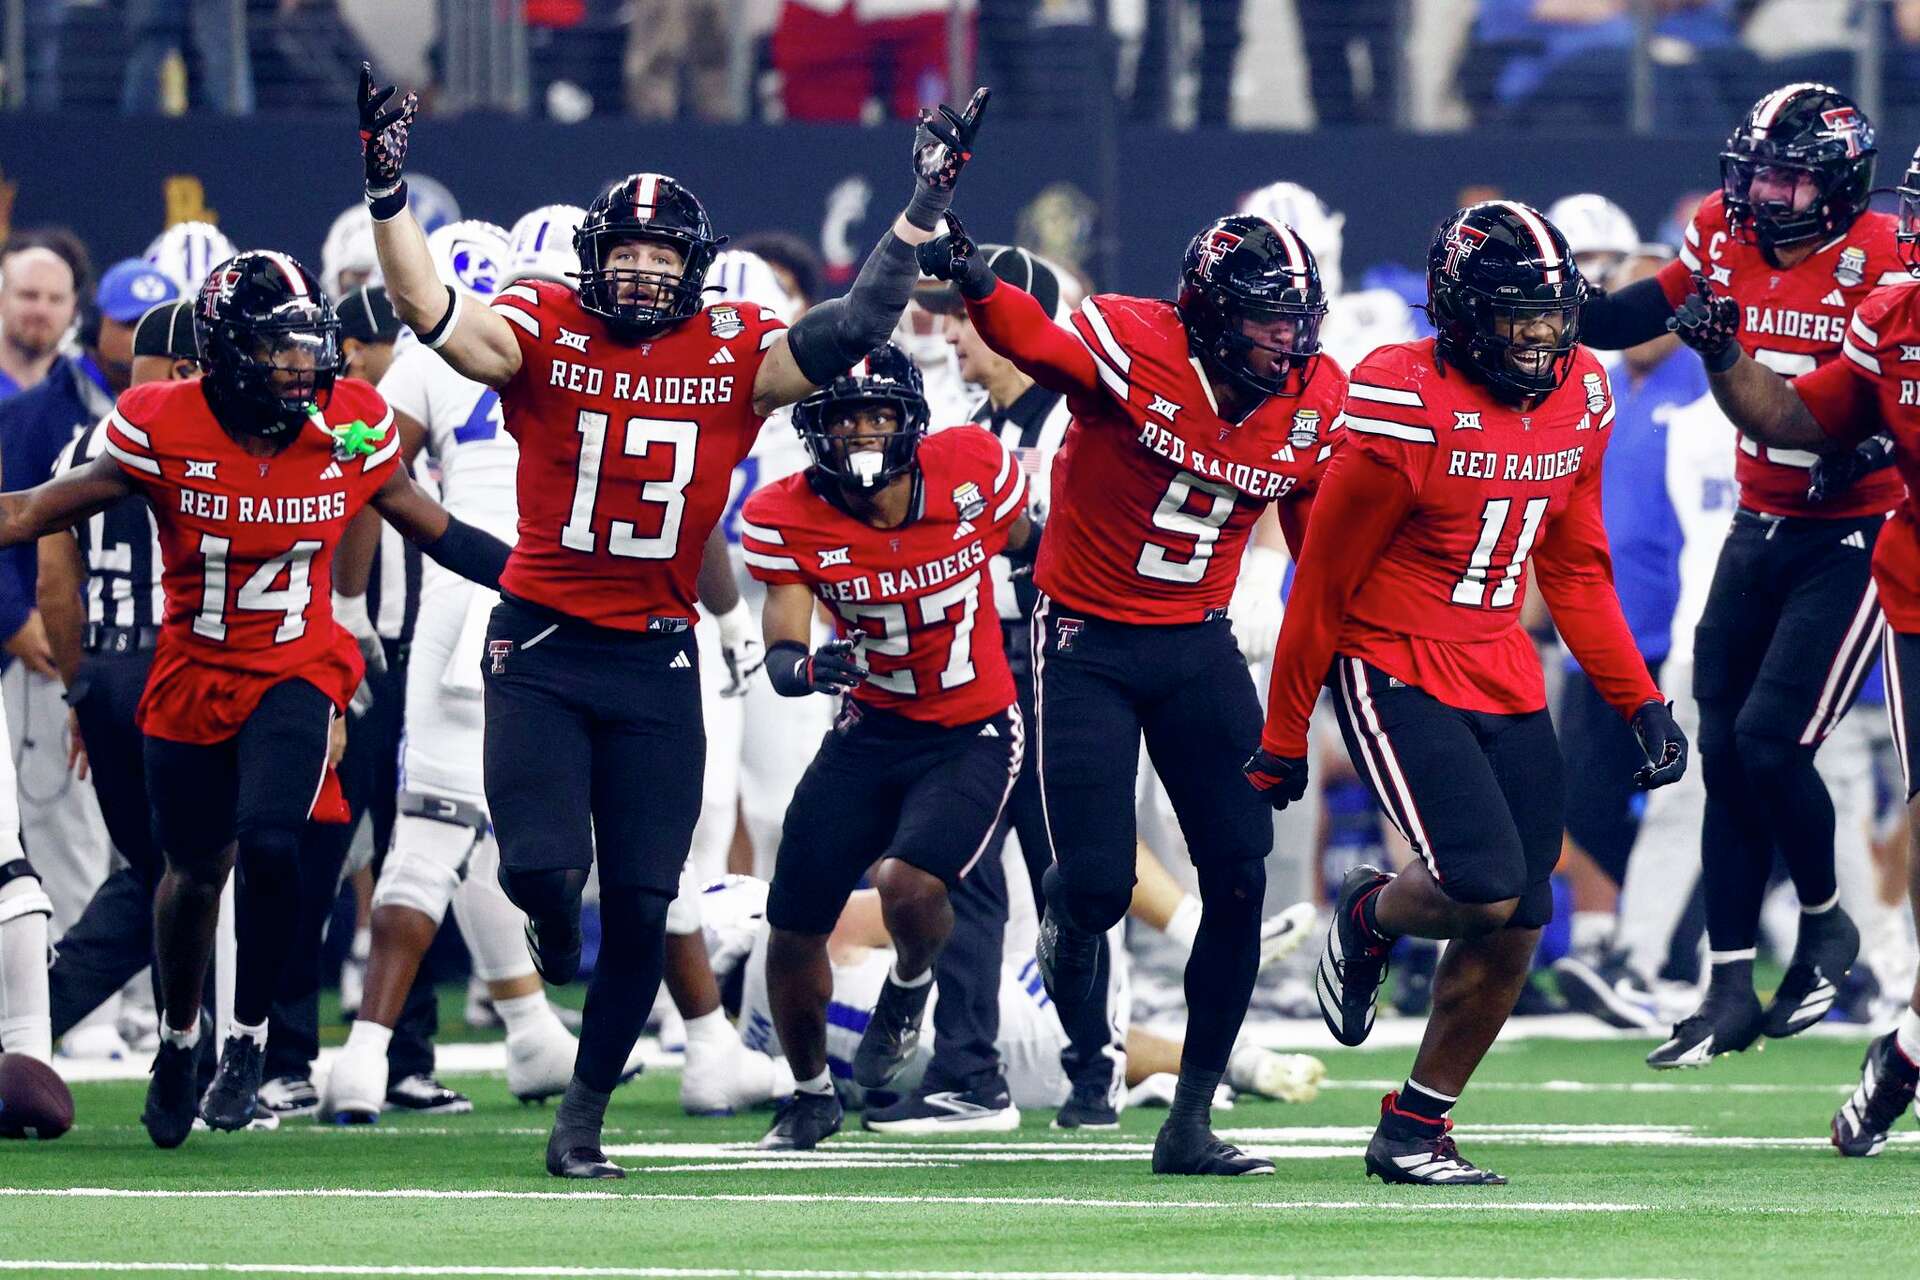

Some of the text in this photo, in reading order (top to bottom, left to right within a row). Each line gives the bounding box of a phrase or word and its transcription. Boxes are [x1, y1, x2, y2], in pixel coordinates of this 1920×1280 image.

[1708, 231, 1727, 260] C
[555, 327, 590, 353] XII
[1745, 306, 1845, 343] RAIDERS
[550, 359, 734, 404] RED RAIDERS
[1147, 394, 1182, 421] XII
[1452, 411, 1483, 431] XII
[185, 460, 217, 480] XII
[1138, 420, 1297, 498] RED RAIDERS
[1448, 446, 1584, 481] RED RAIDERS
[561, 410, 699, 559] 13
[180, 488, 346, 524] RED RAIDERS
[1136, 470, 1240, 583] 9
[817, 547, 851, 569] XII
[819, 540, 986, 602] RED RAIDERS
[1452, 498, 1549, 608] 11
[192, 533, 323, 643] 14
[838, 569, 982, 696] 27
